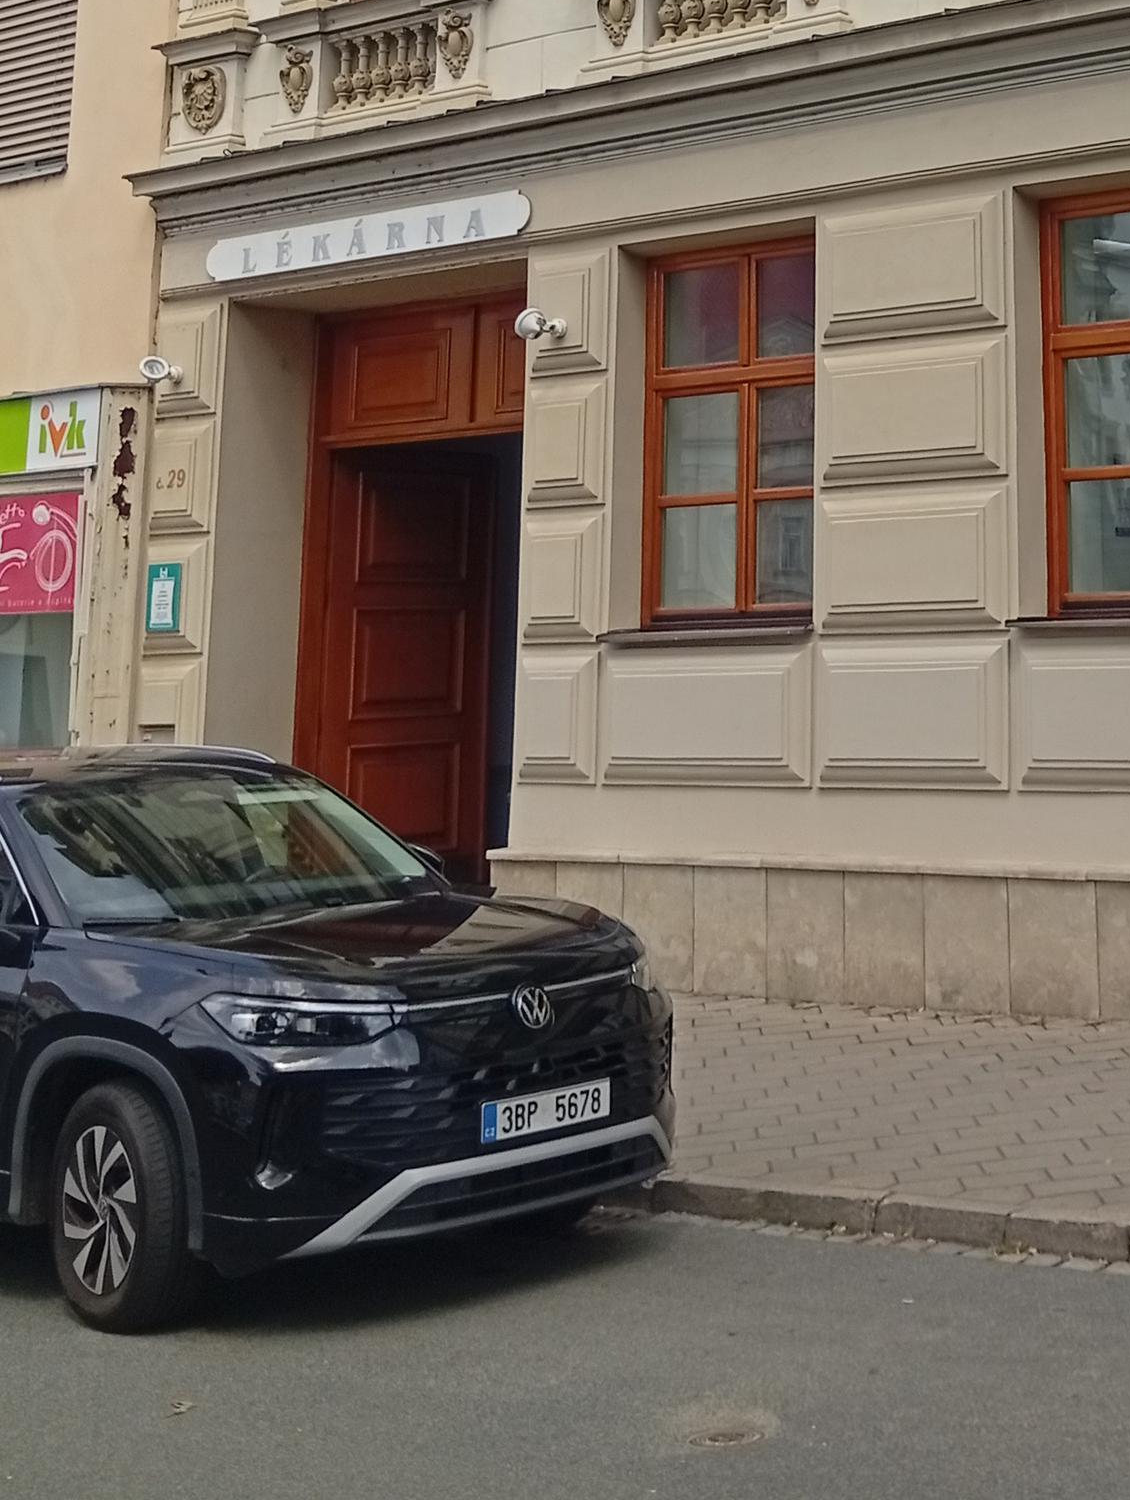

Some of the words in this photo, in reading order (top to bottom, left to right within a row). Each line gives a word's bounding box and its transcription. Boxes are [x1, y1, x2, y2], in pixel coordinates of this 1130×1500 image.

[241, 209, 486, 274] LÉKÁRNA
[502, 1101, 538, 1133] 3BP
[555, 1087, 601, 1122] 5678
